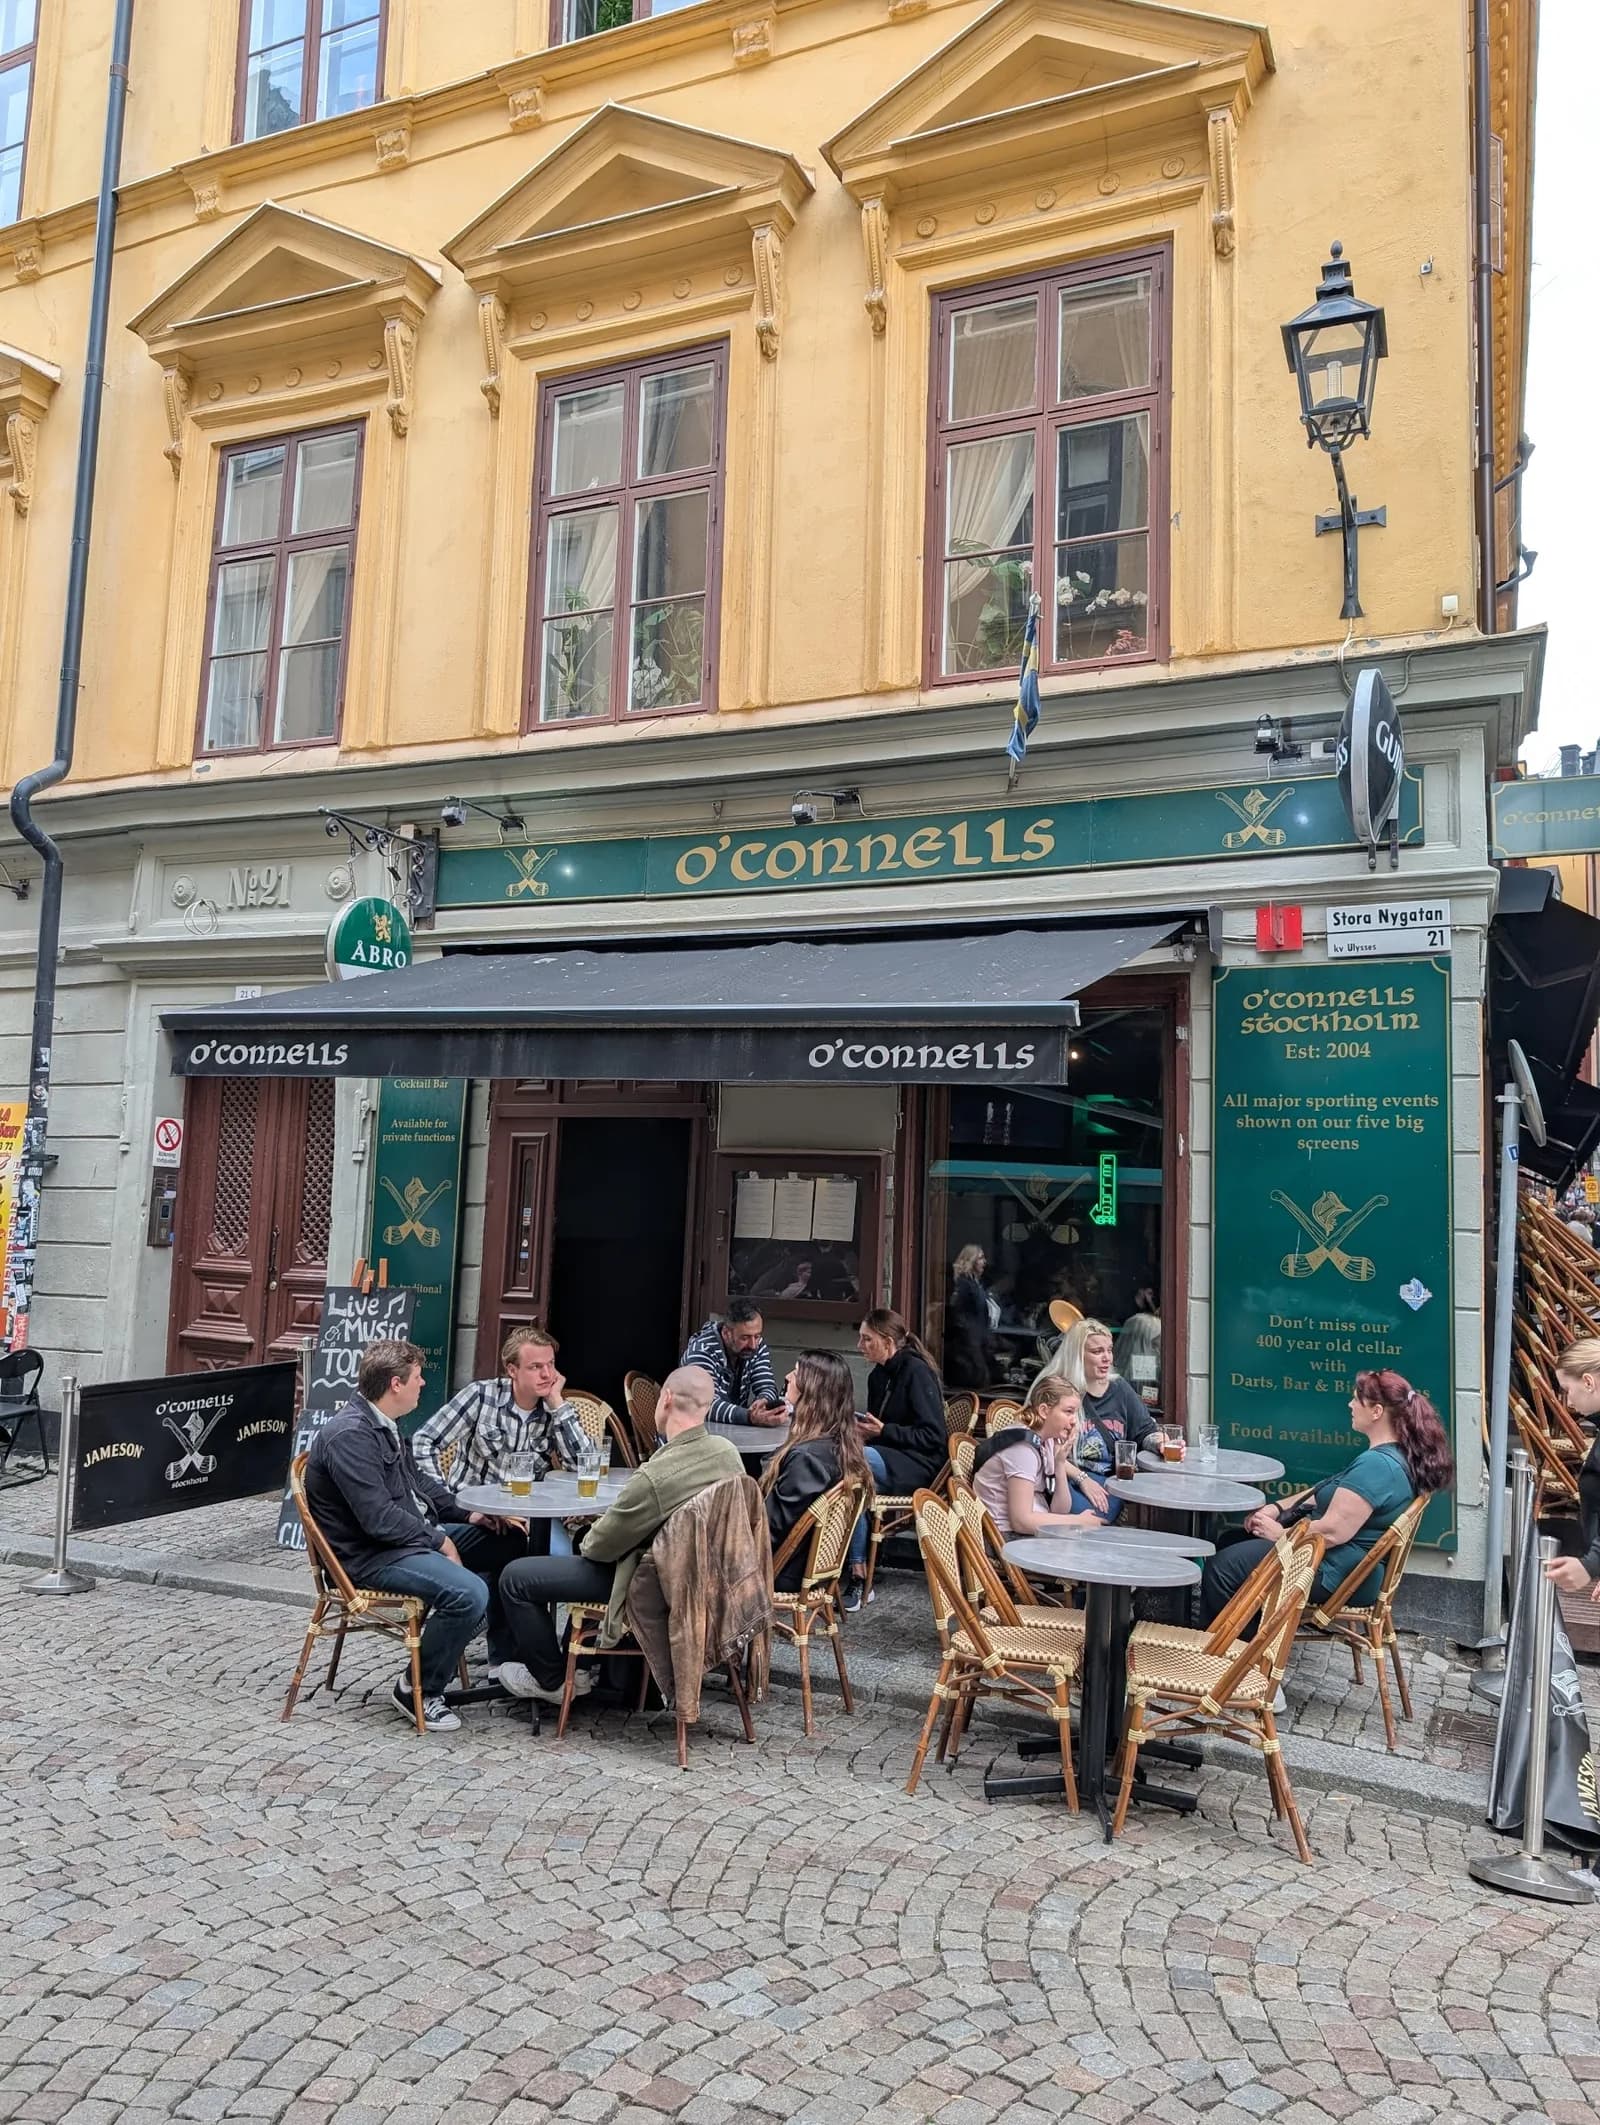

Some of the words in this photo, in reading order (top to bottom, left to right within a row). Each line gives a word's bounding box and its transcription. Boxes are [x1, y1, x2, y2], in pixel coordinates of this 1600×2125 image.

[1333, 911, 1372, 926] Stora
[1378, 907, 1443, 927] Nygatan
[1427, 929, 1444, 947] 21
[351, 940, 407, 969] ÅBRO
[1333, 944, 1344, 953] kv
[1347, 943, 1377, 953] Ulysses
[1285, 1043, 1320, 1059] Est:
[1326, 1042, 1371, 1059] 2004
[394, 1079, 431, 1089] Cocktail
[433, 1079, 449, 1089] Bar
[1223, 1094, 1248, 1108] All
[1253, 1094, 1301, 1112] major
[1306, 1094, 1378, 1112] sporting
[1382, 1094, 1439, 1108] events
[391, 1119, 433, 1129] Available
[435, 1119, 449, 1129] for
[1236, 1115, 1291, 1129] shown
[1296, 1118, 1317, 1128] on
[1322, 1118, 1351, 1129] our
[1356, 1115, 1390, 1129] five
[1395, 1115, 1425, 1133] big
[382, 1132, 412, 1143] private
[414, 1132, 456, 1143] functions
[1297, 1138, 1360, 1150] screens
[1269, 1314, 1316, 1331] Don't
[1319, 1320, 1357, 1332] miss
[1361, 1323, 1390, 1334] our
[1256, 1334, 1282, 1348] 400
[1287, 1339, 1321, 1352] year
[1326, 1339, 1352, 1353] old
[1357, 1342, 1403, 1355] cellar
[1310, 1360, 1346, 1373] with
[1231, 1373, 1278, 1391] Darts,
[1283, 1377, 1310, 1391] Bar
[1315, 1380, 1328, 1392] &
[236, 1419, 288, 1442] JAMESON
[1231, 1423, 1273, 1440] Food
[1279, 1428, 1362, 1447] available
[83, 1442, 144, 1468] JAMESON
